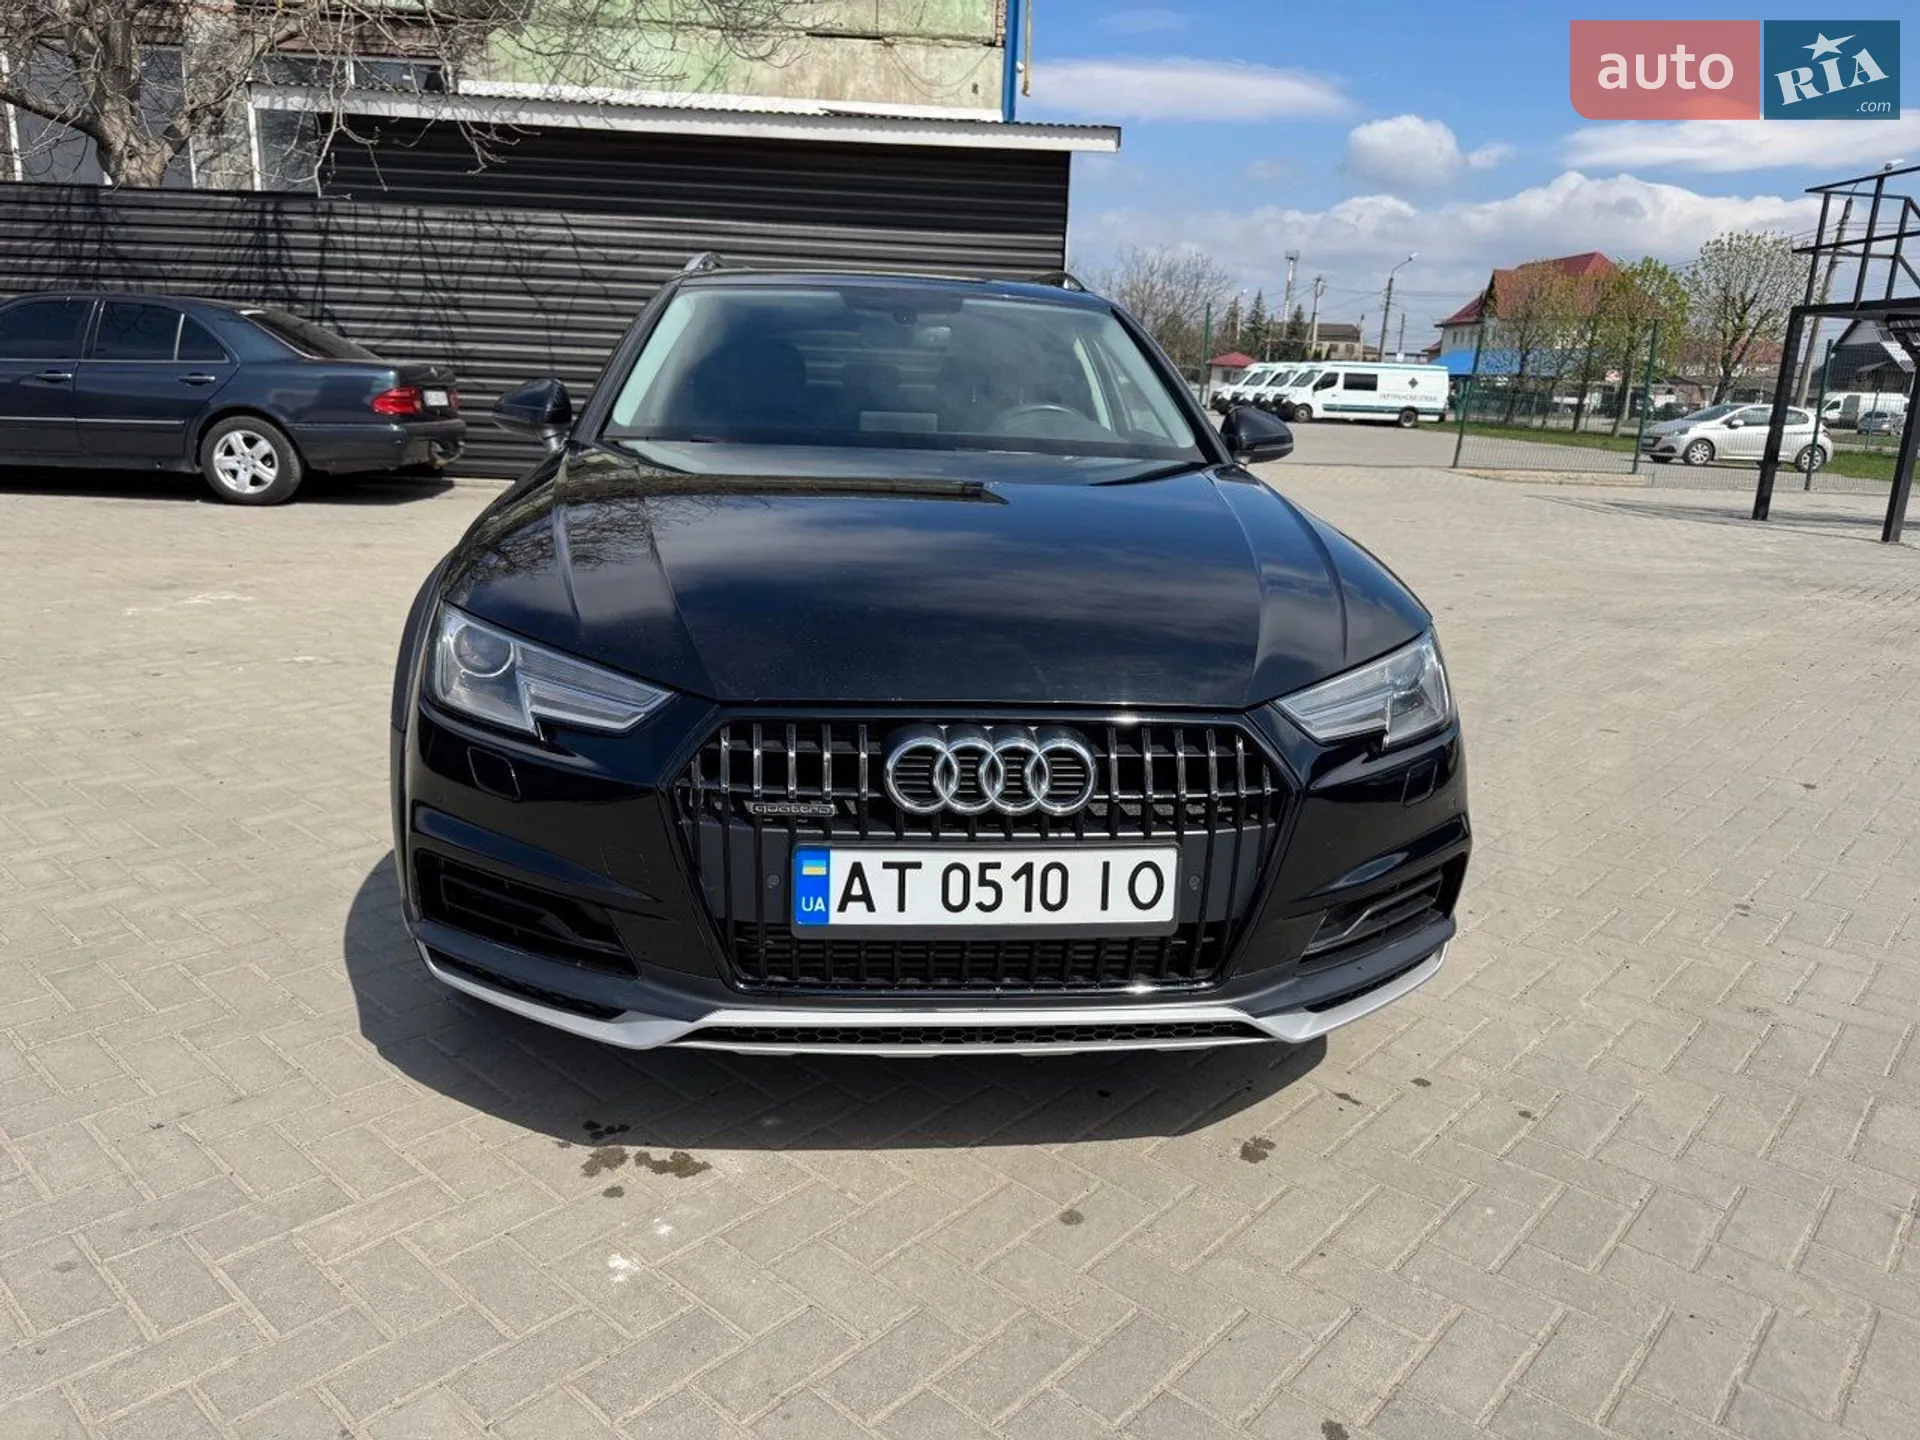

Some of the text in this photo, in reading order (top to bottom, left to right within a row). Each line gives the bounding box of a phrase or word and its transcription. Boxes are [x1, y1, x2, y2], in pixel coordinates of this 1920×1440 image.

[754, 804, 831, 815] quattro
[836, 860, 1164, 914] AT 0510 IO
[801, 896, 827, 912] UA
